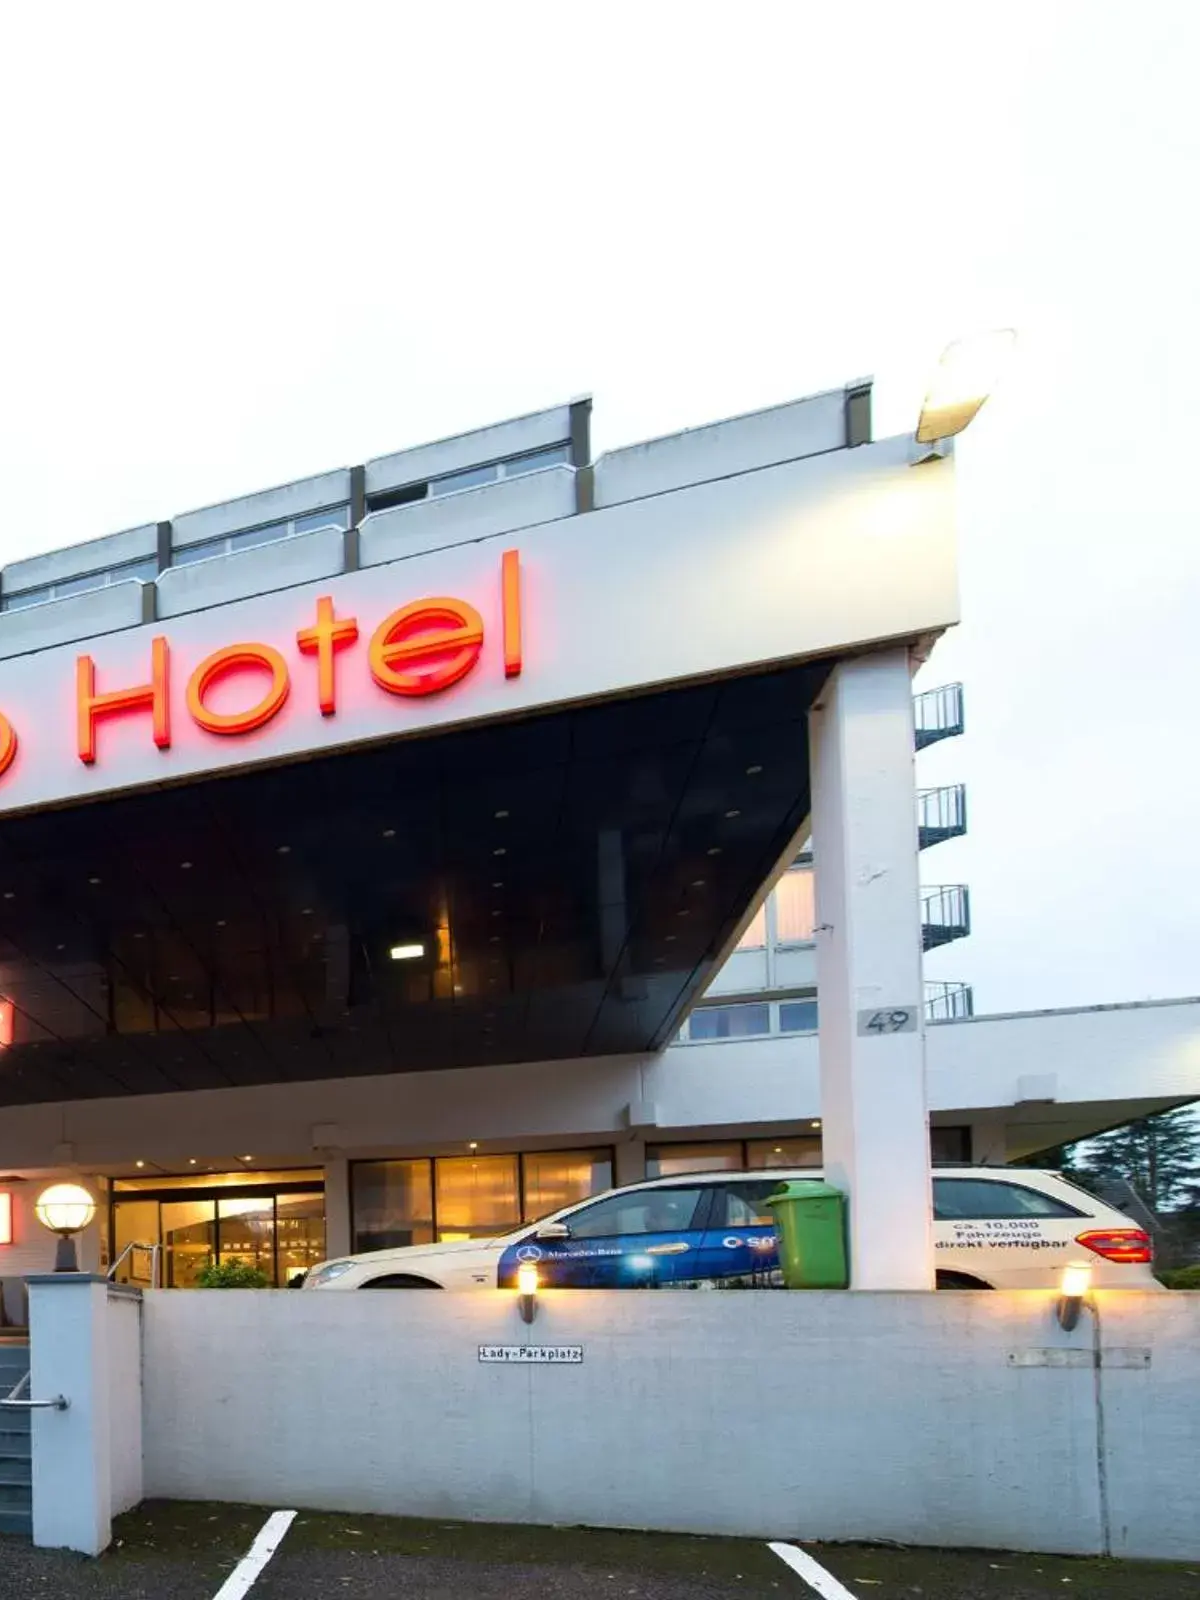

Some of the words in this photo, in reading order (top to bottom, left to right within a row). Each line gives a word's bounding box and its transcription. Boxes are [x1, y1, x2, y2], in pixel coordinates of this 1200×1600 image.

[76, 548, 522, 765] Hotel
[865, 1010, 909, 1032] 49
[956, 1231, 1042, 1239] Fahrzeuge
[935, 1240, 983, 1248] direkt
